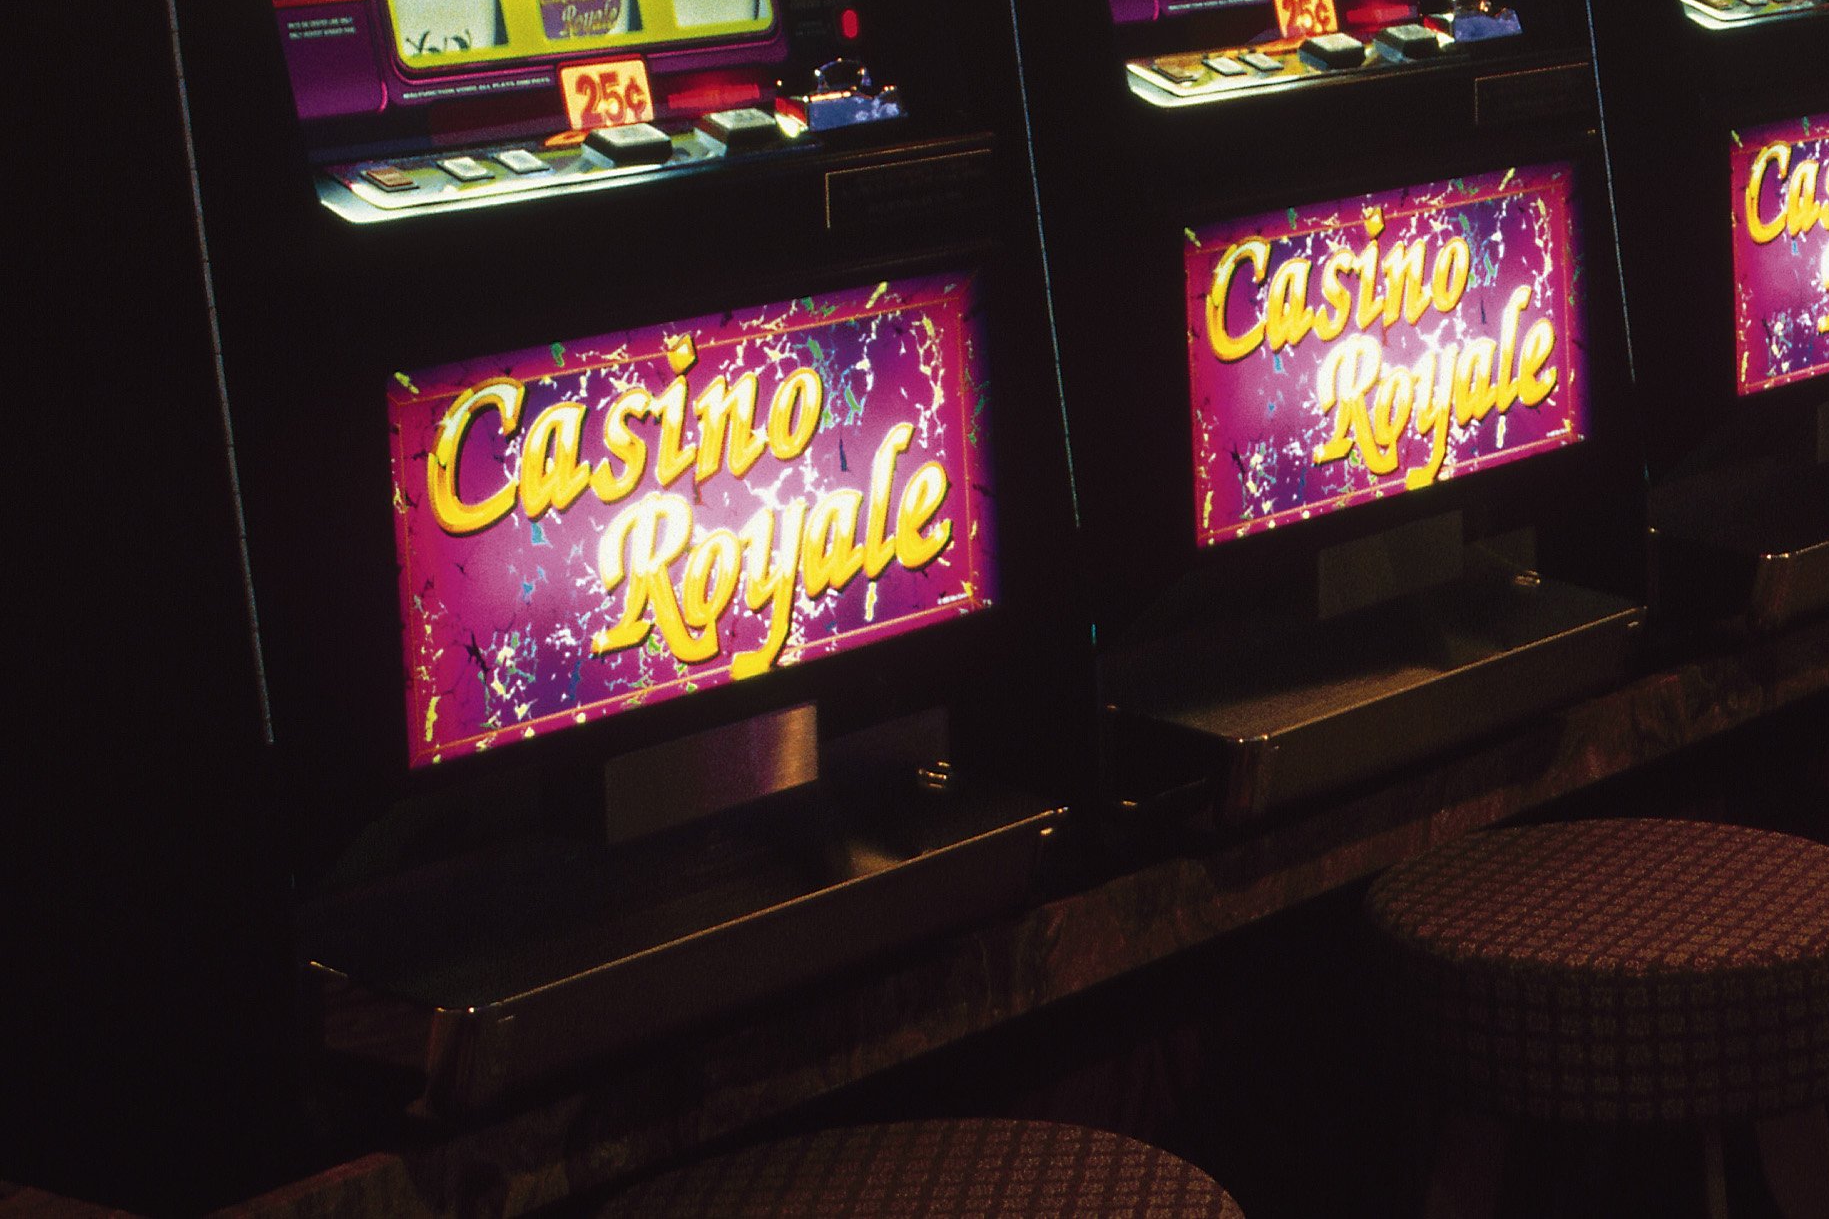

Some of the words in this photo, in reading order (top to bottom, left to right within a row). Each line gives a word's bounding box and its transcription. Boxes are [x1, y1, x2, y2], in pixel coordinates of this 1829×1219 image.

[575, 70, 648, 128] 25¢
[1206, 207, 1470, 362] Casino
[428, 334, 824, 537] Casino
[1313, 285, 1557, 492] Royale
[591, 422, 952, 682] Royale
